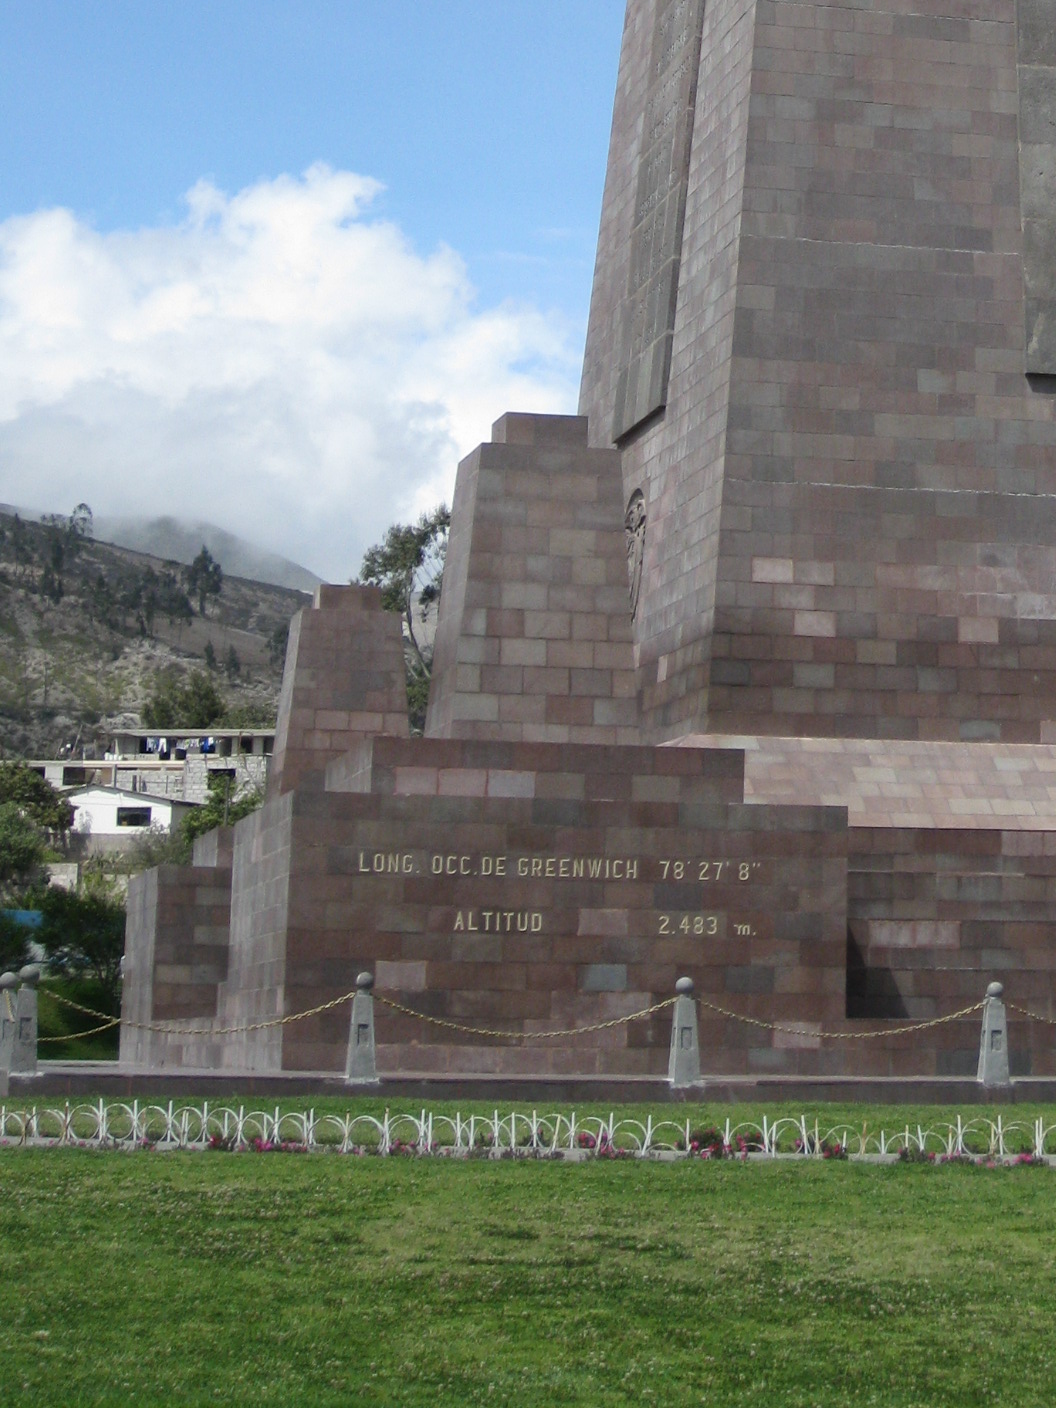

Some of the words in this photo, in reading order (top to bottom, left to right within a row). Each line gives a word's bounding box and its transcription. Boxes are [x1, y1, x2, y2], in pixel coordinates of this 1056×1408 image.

[359, 852, 421, 874] LONG.
[518, 857, 638, 879] GREENWICH
[453, 911, 543, 932] ALTITUD
[658, 915, 718, 935] 2.483
